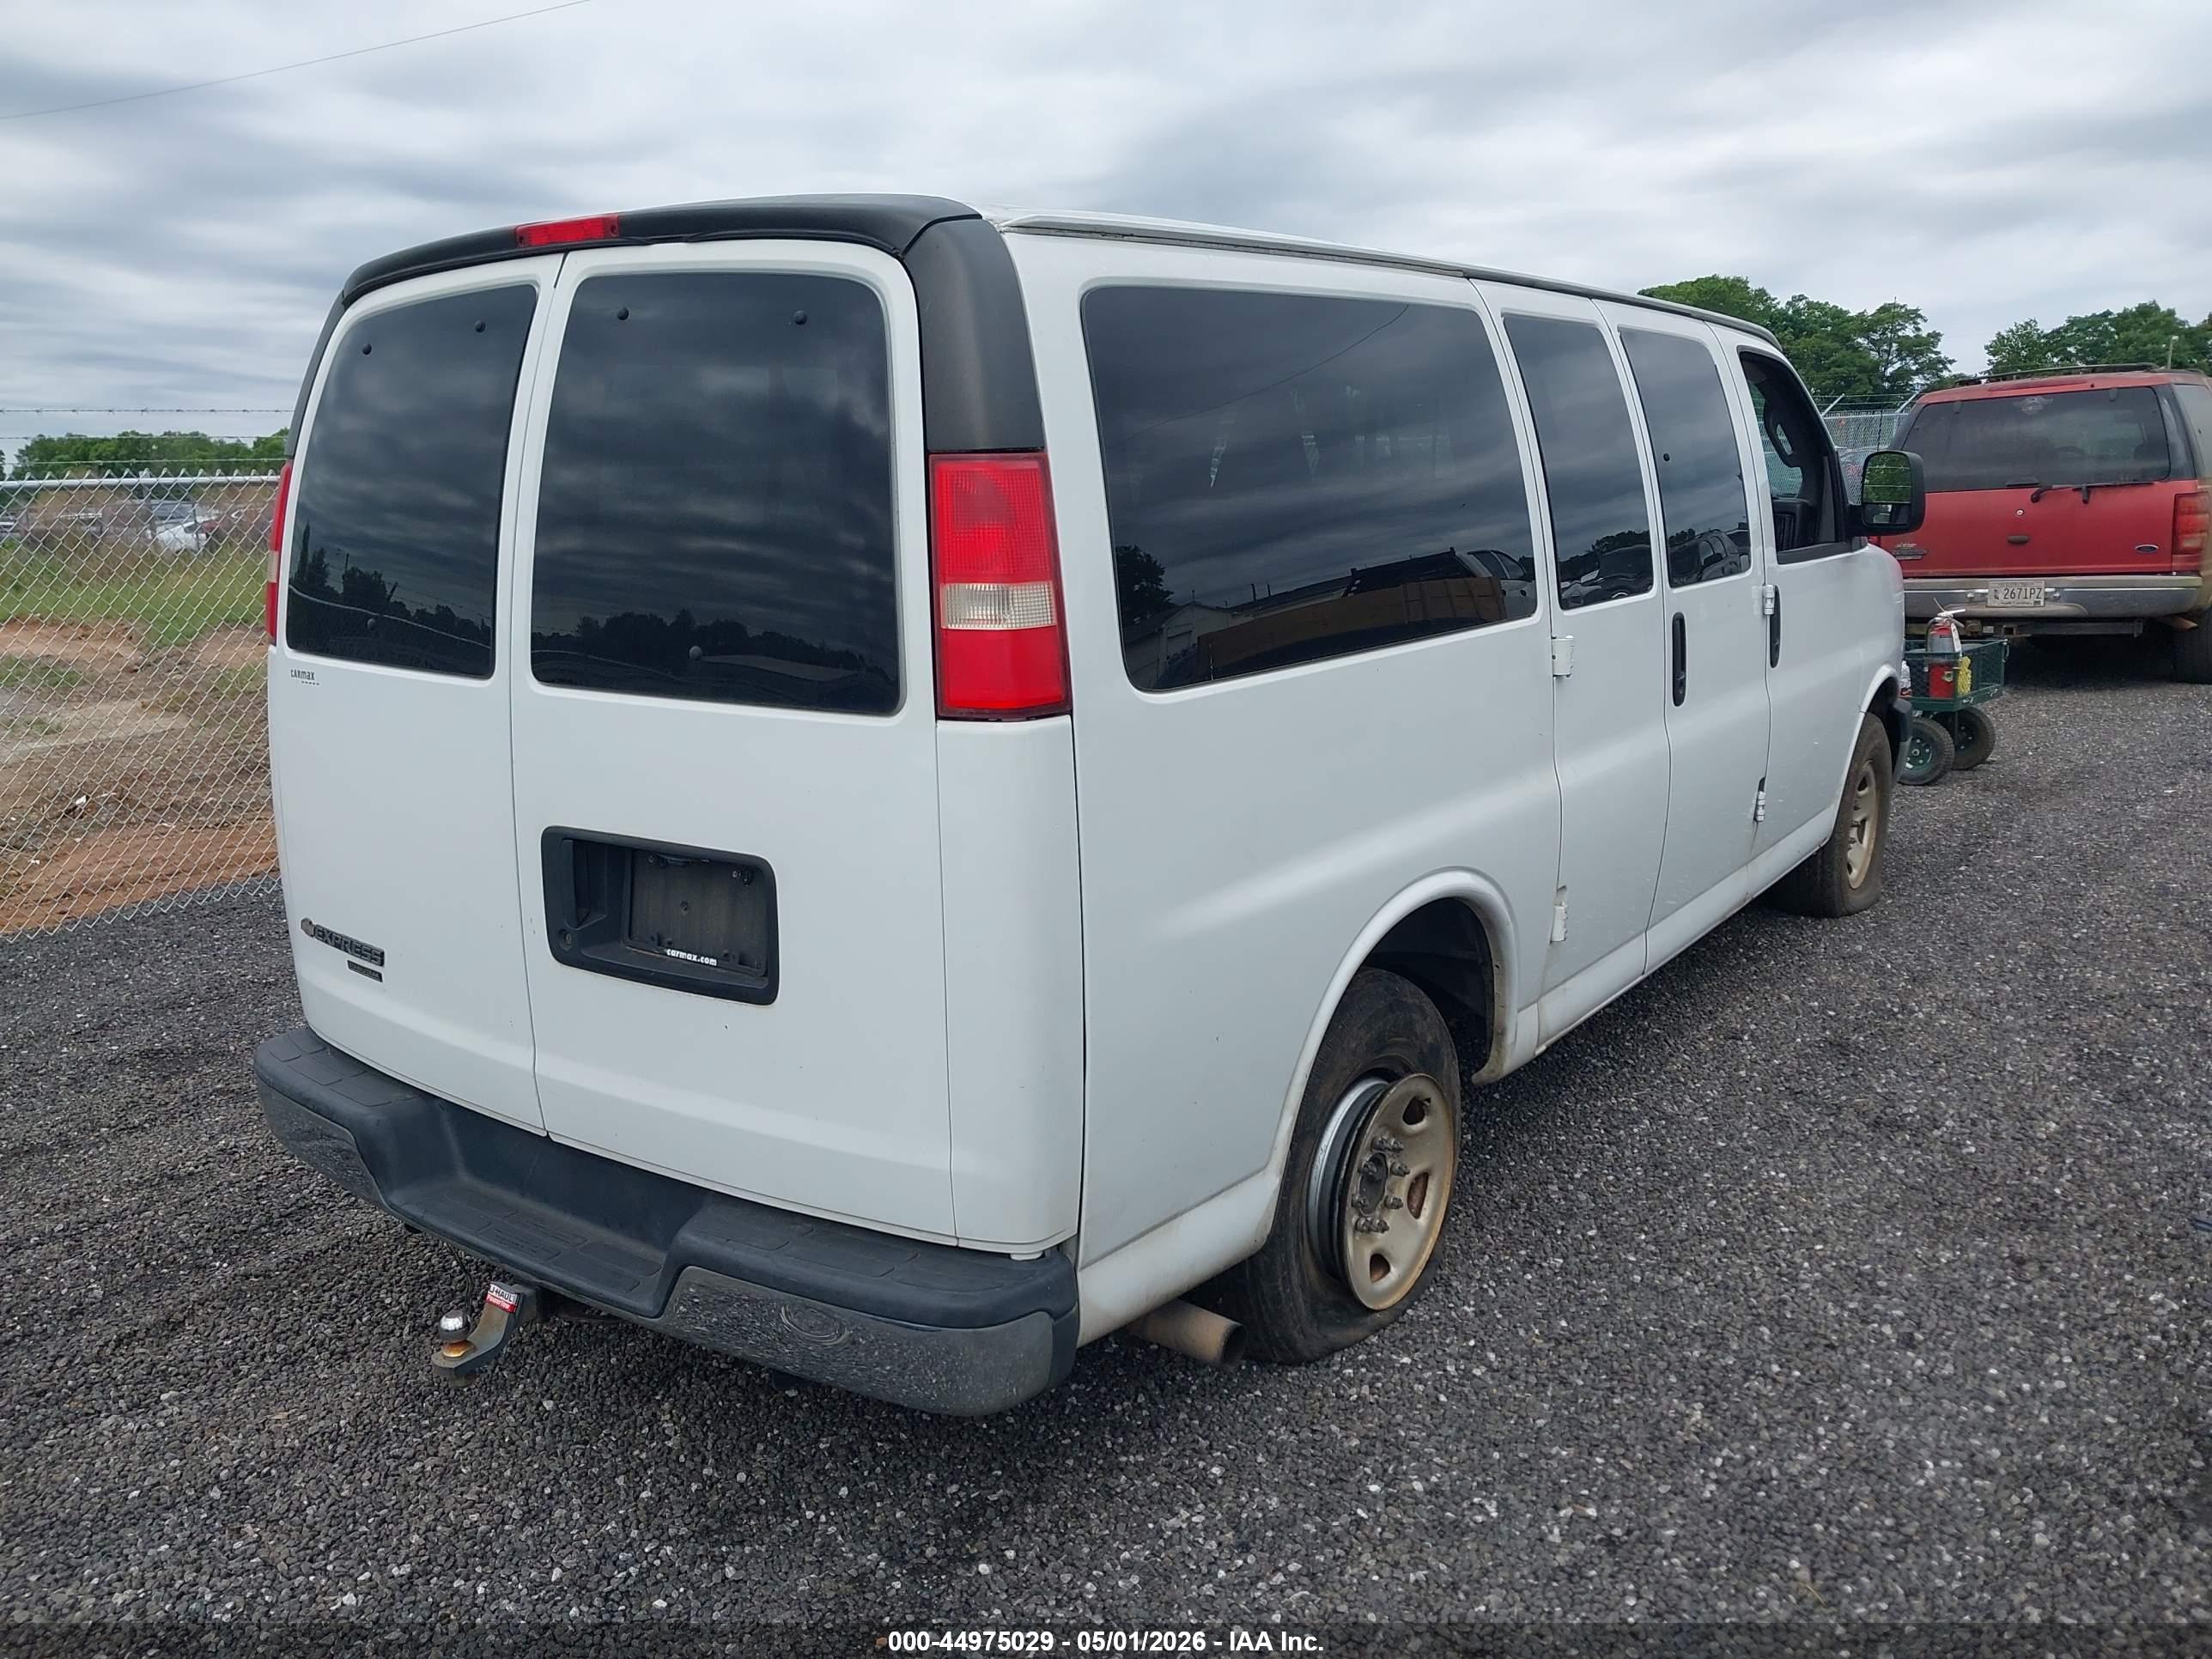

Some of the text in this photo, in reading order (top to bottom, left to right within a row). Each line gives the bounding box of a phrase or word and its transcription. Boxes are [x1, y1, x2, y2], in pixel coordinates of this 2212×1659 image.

[2003, 587, 2043, 600] 2671PZ
[314, 926, 383, 966] EXPRESS
[665, 948, 718, 967] carmax.com
